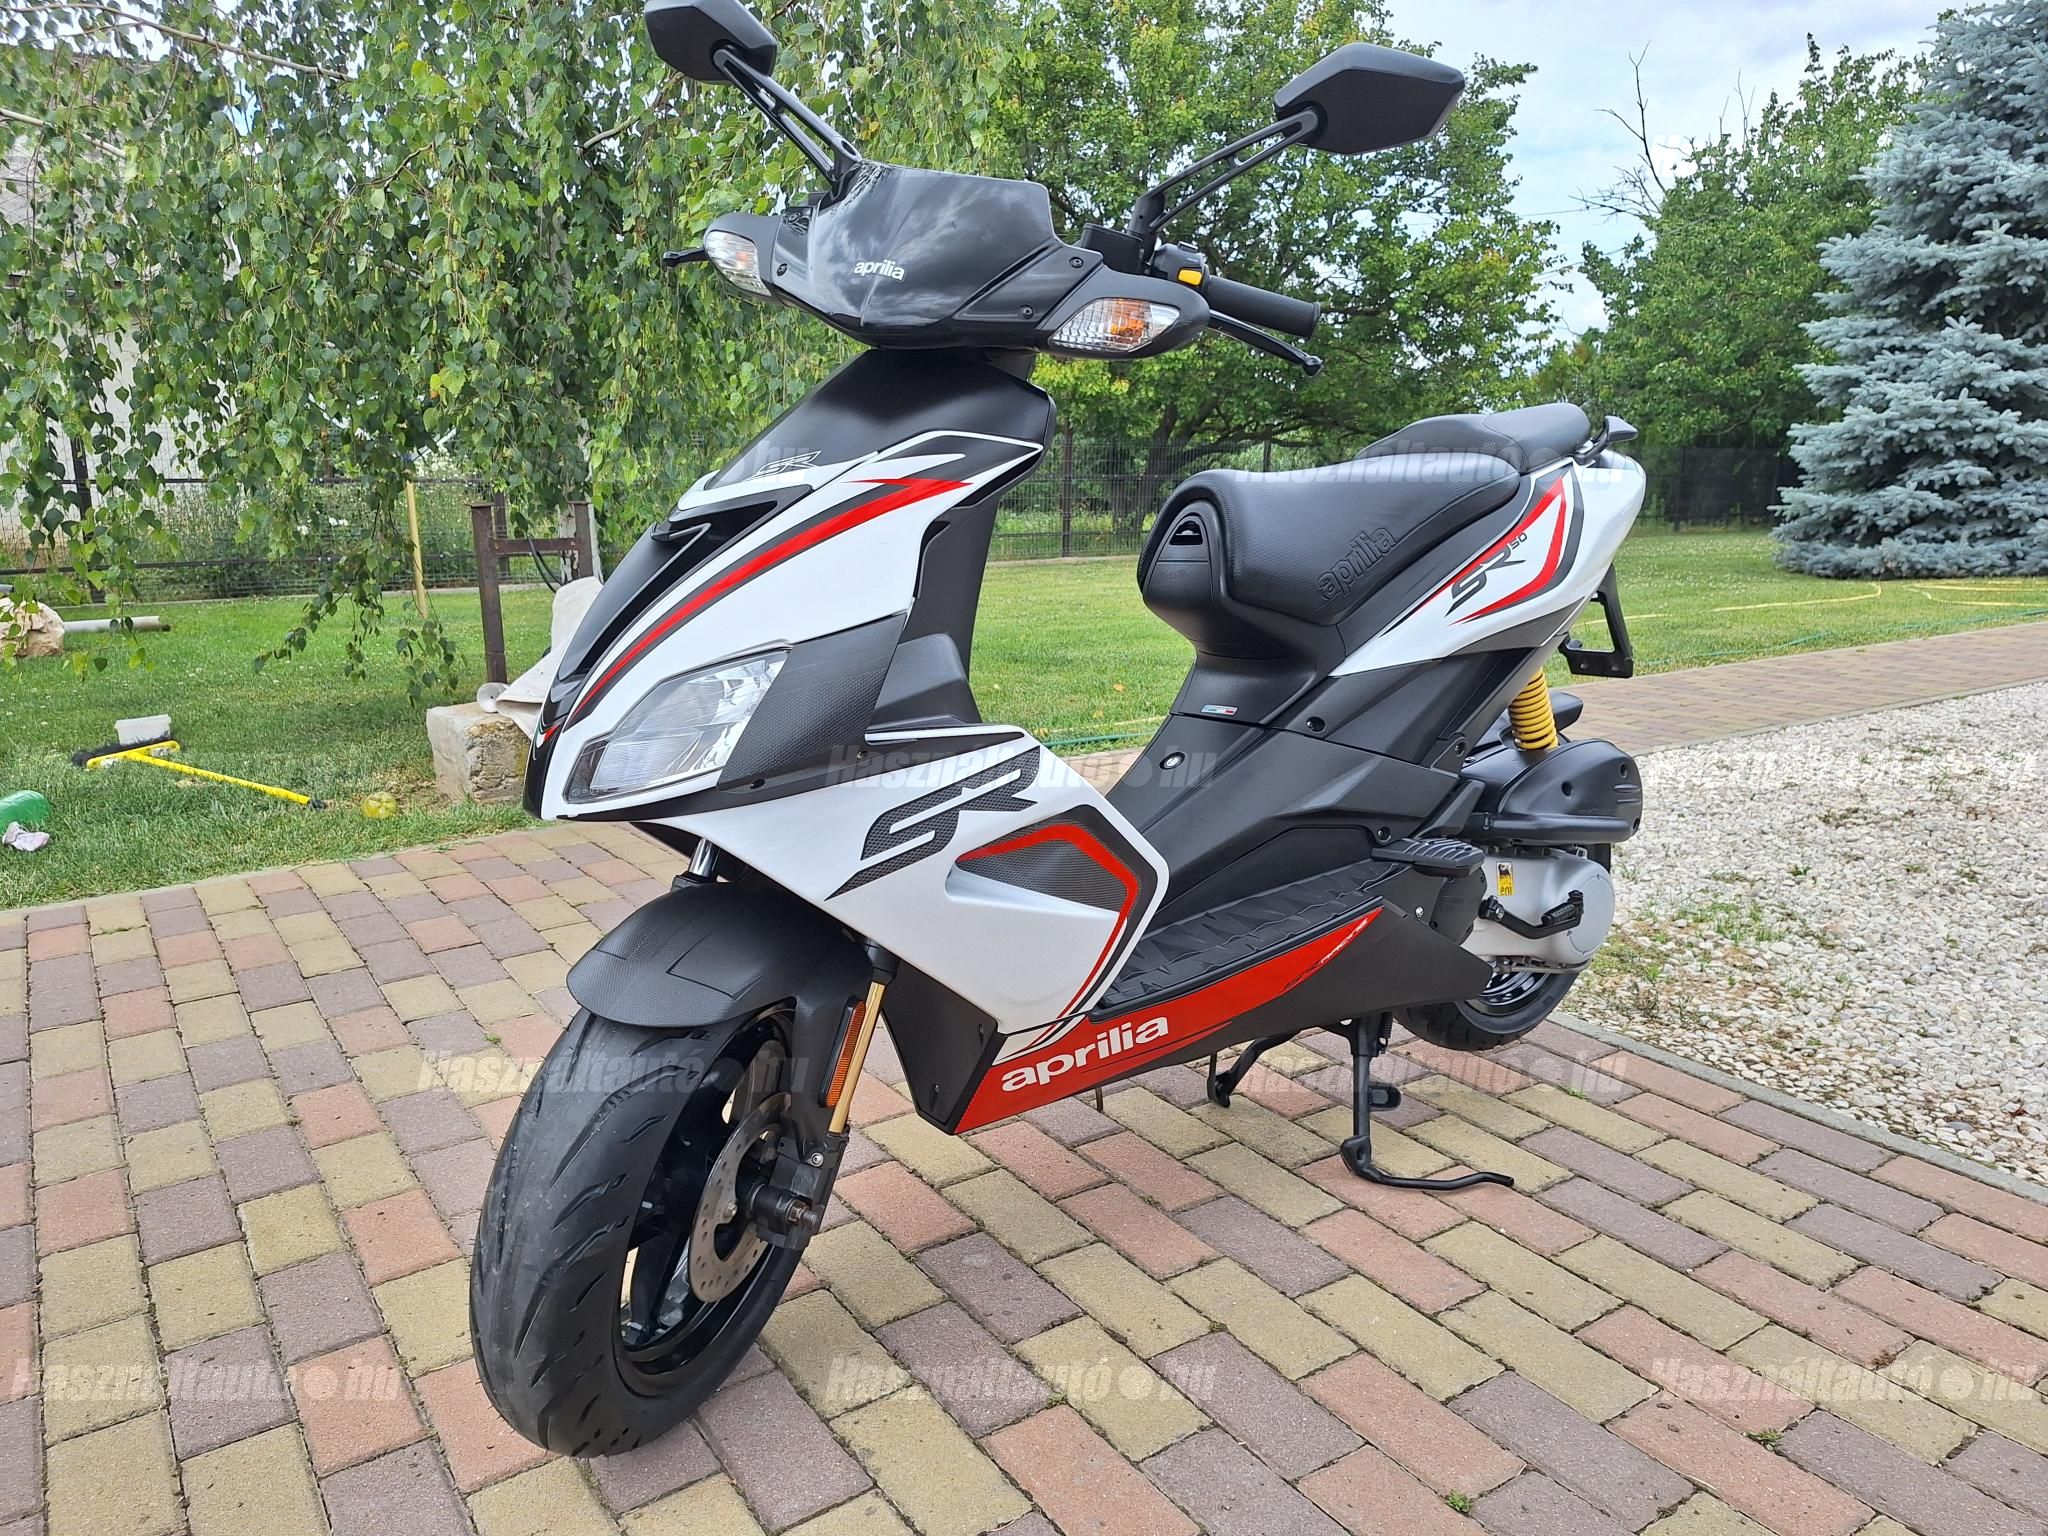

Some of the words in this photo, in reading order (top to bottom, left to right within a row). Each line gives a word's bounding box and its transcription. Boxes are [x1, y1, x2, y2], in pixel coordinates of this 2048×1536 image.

[853, 259, 905, 281] aprilia
[1317, 527, 1397, 600] aprilia
[1444, 544, 1526, 617] SR
[1509, 531, 1527, 550] 50
[824, 745, 1041, 901] SR
[1500, 882, 1512, 896] eni
[1001, 1016, 1169, 1092] aprilia
